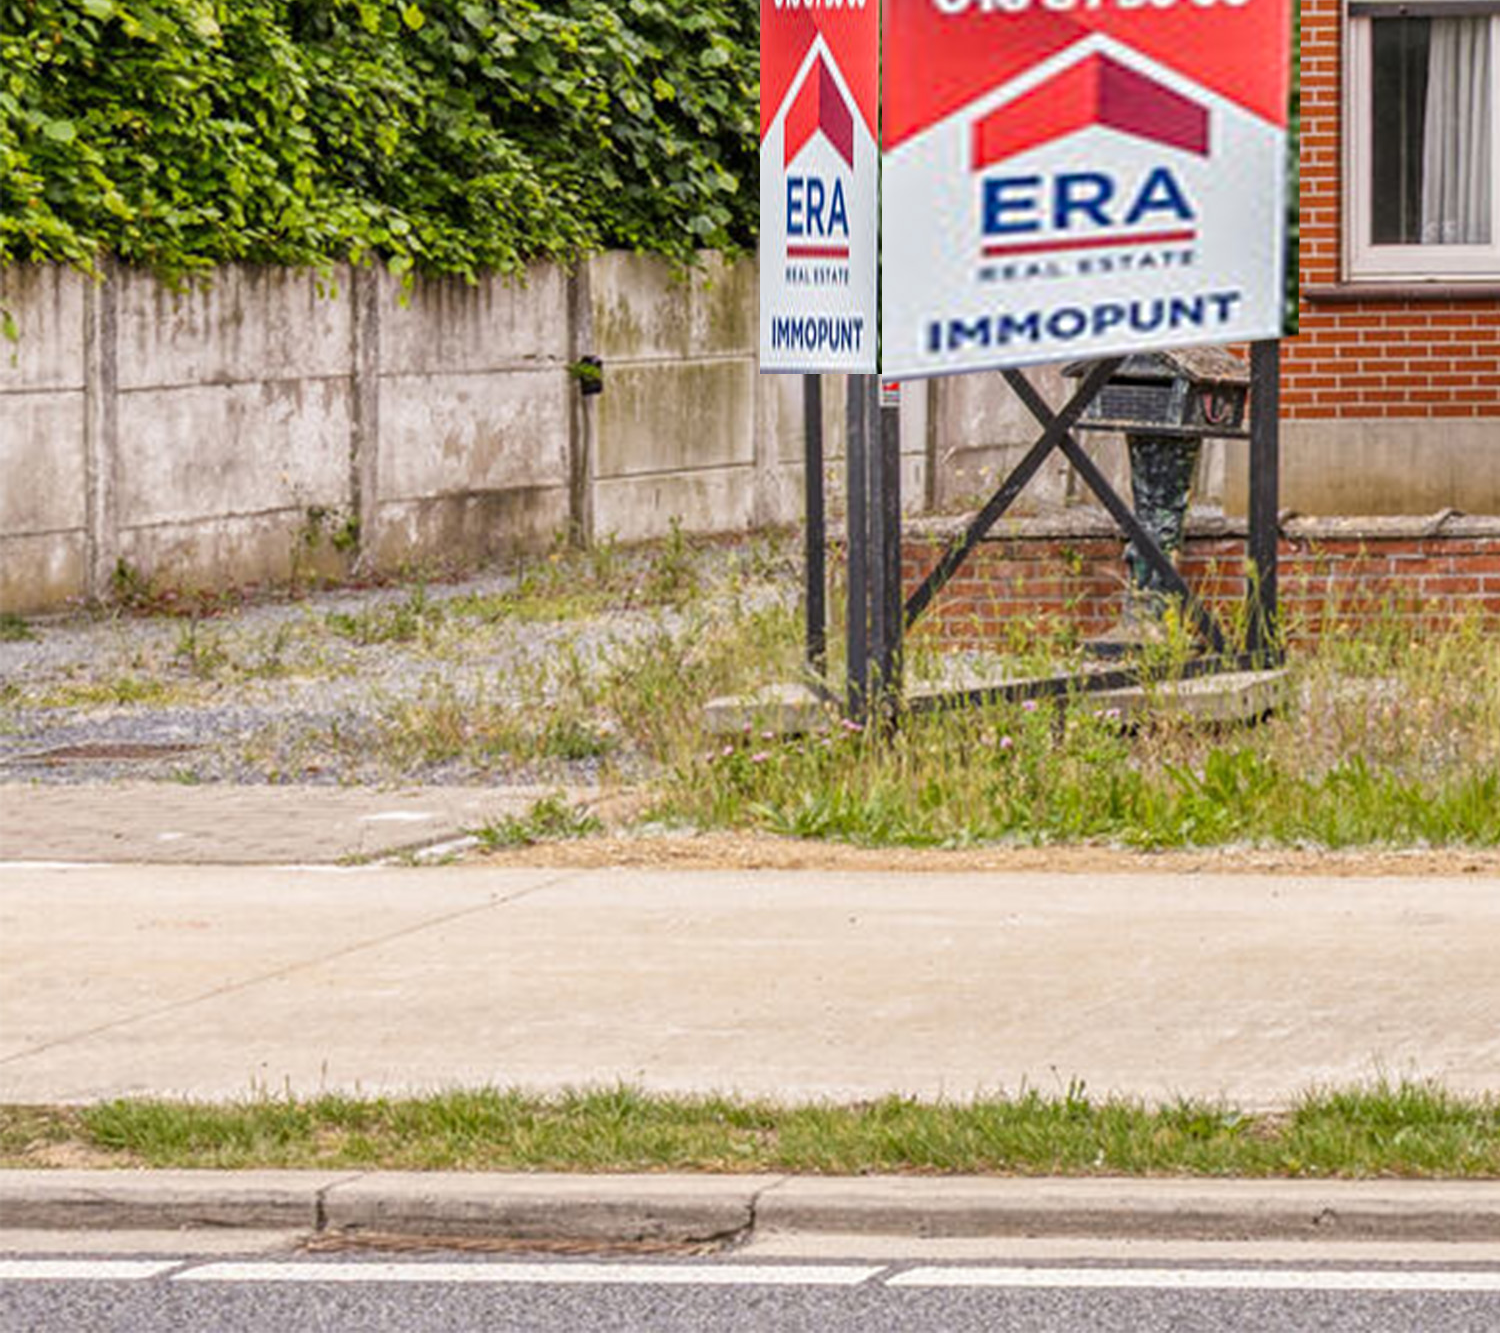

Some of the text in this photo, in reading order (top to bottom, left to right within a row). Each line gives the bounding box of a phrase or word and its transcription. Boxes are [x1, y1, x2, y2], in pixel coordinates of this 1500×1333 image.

[787, 177, 849, 236] ERA
[982, 167, 1195, 235] ERA
[786, 266, 849, 284] REAL ESTATE
[979, 250, 1193, 281] REAL ESTATE
[772, 317, 863, 352] IMMOPUNT
[929, 291, 1240, 353] IMMOPUNT
